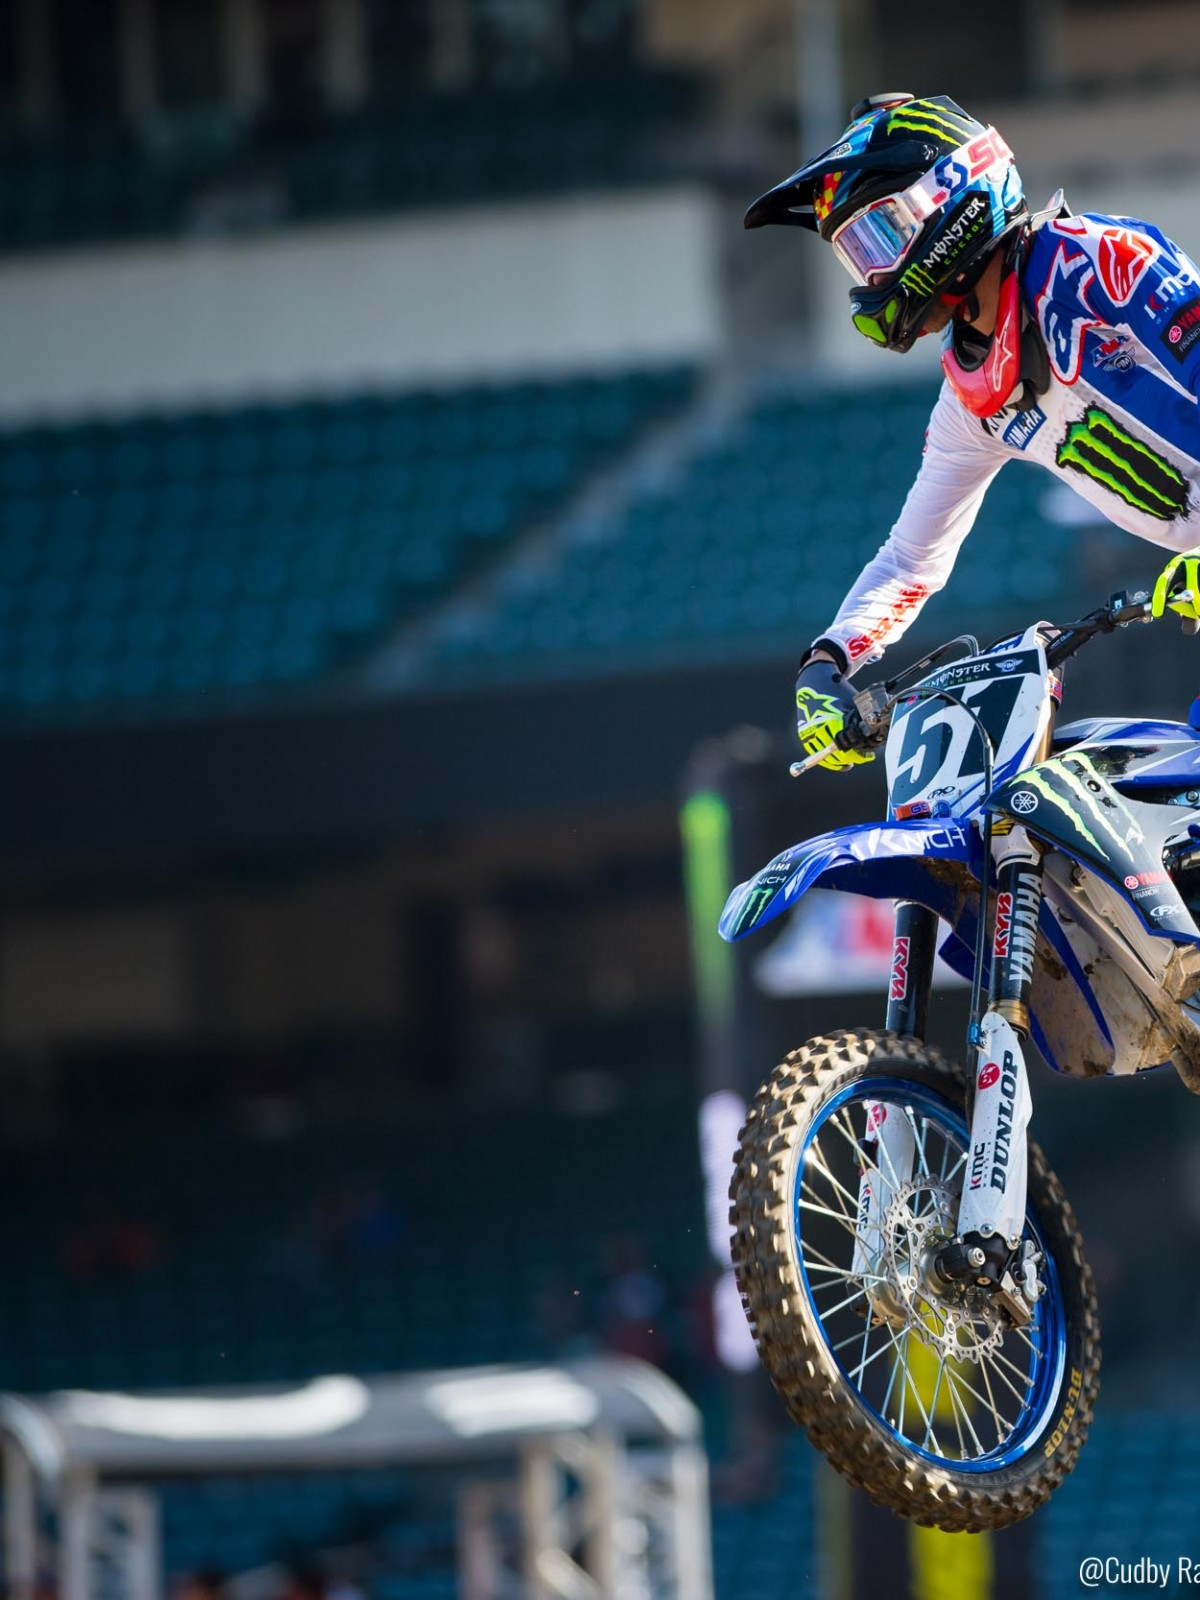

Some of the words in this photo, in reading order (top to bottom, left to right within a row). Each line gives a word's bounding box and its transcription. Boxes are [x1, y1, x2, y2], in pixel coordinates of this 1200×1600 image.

[923, 197, 986, 269] MONSTER
[943, 216, 985, 266] ENERGY
[931, 662, 991, 687] MONSTER
[891, 676, 1026, 803] 51
[993, 892, 1014, 958] KYB
[1009, 873, 1042, 985] YAMAHA
[890, 937, 911, 1001] KYB
[990, 1050, 1019, 1194] DUNLOP
